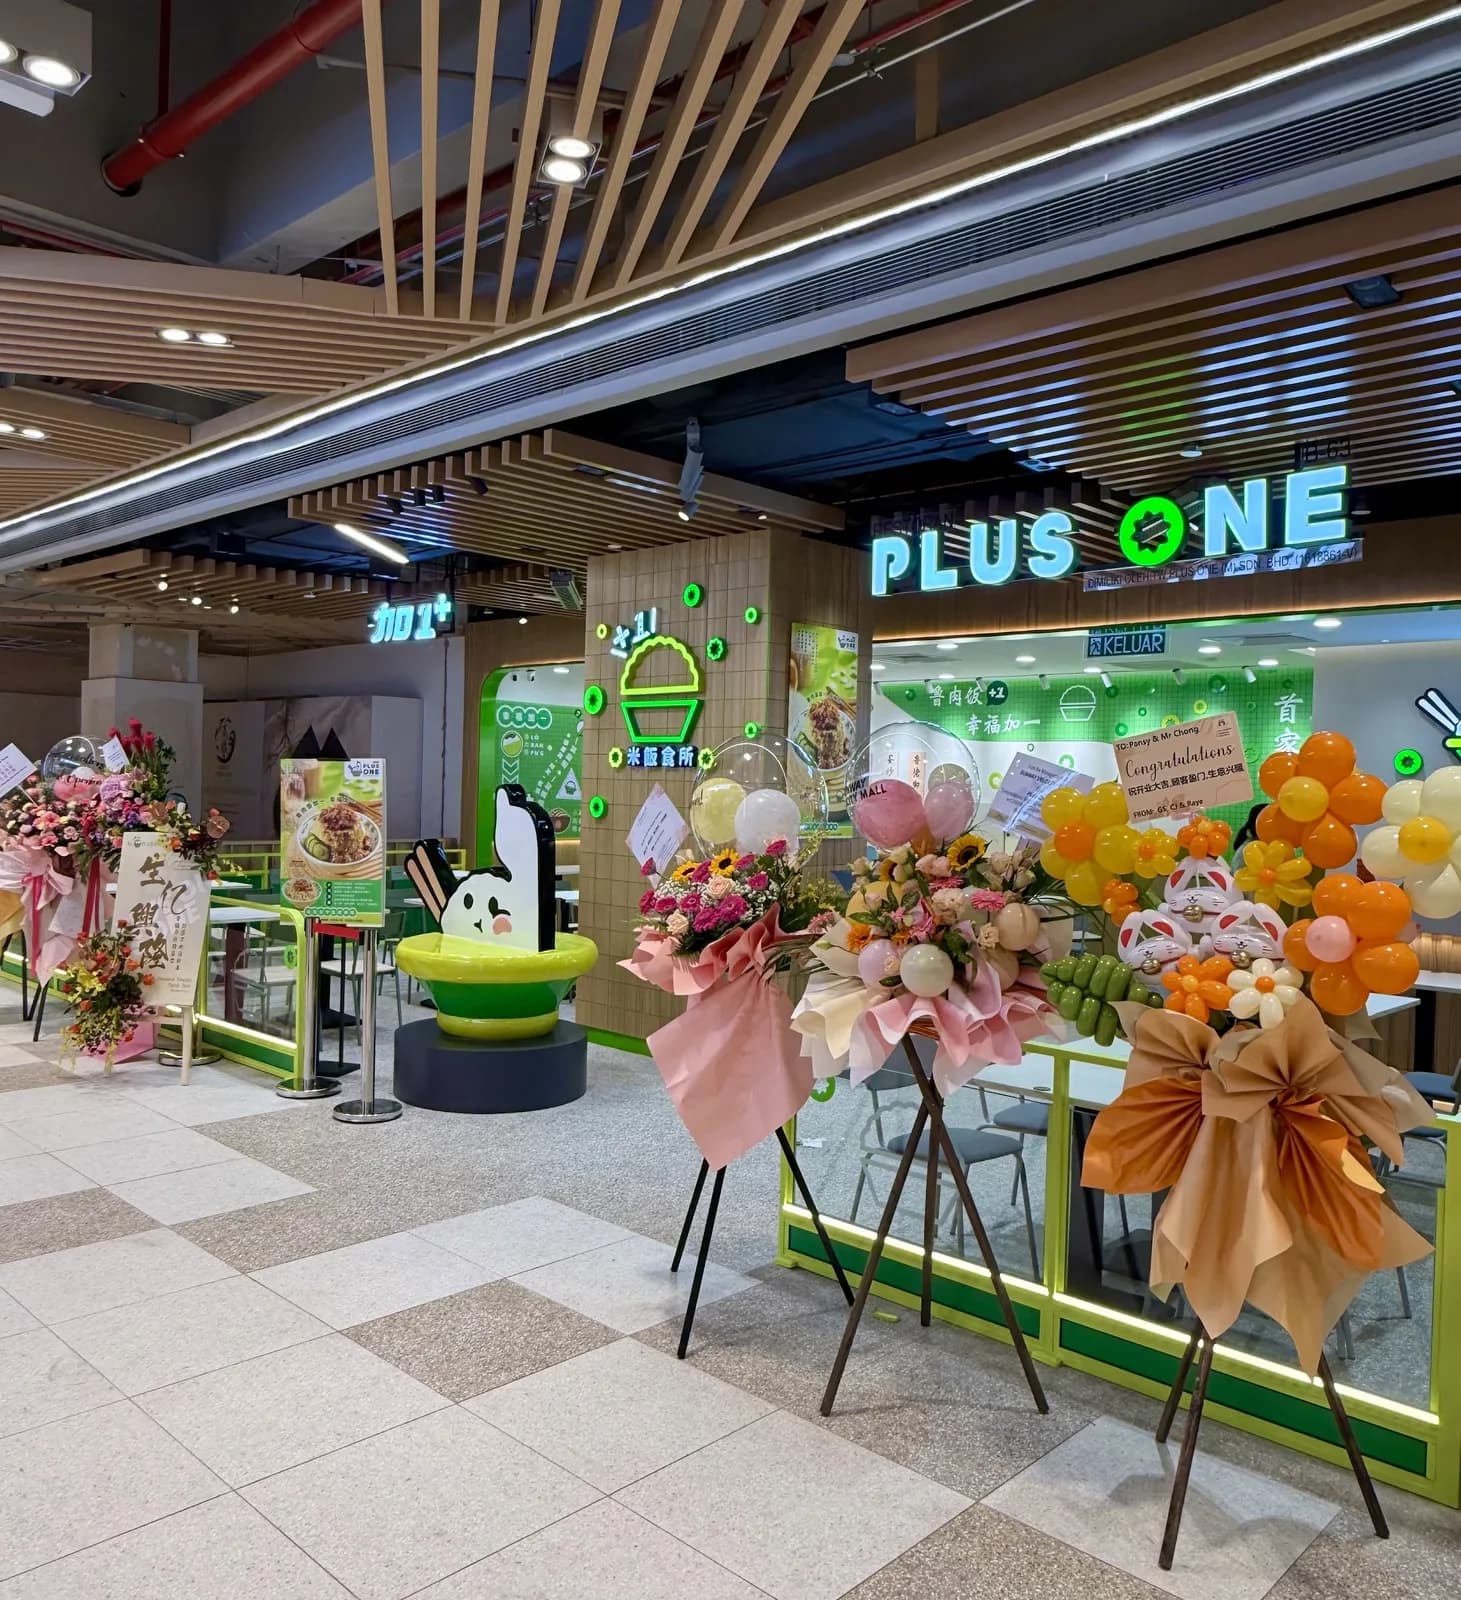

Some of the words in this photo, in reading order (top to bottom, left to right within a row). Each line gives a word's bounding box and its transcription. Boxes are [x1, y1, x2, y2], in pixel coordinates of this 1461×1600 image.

[871, 512, 1075, 596] PLUS
[1169, 565, 1194, 578] PLUS
[1196, 561, 1219, 576] ONE
[1103, 633, 1163, 655] KELUAR
[965, 713, 1041, 736] 幸福加一
[1161, 731, 1172, 741] Mr
[1173, 725, 1200, 737] Chong
[627, 745, 695, 767] 米飯食所
[1125, 744, 1234, 781] Congratulations
[860, 783, 887, 800] MALL
